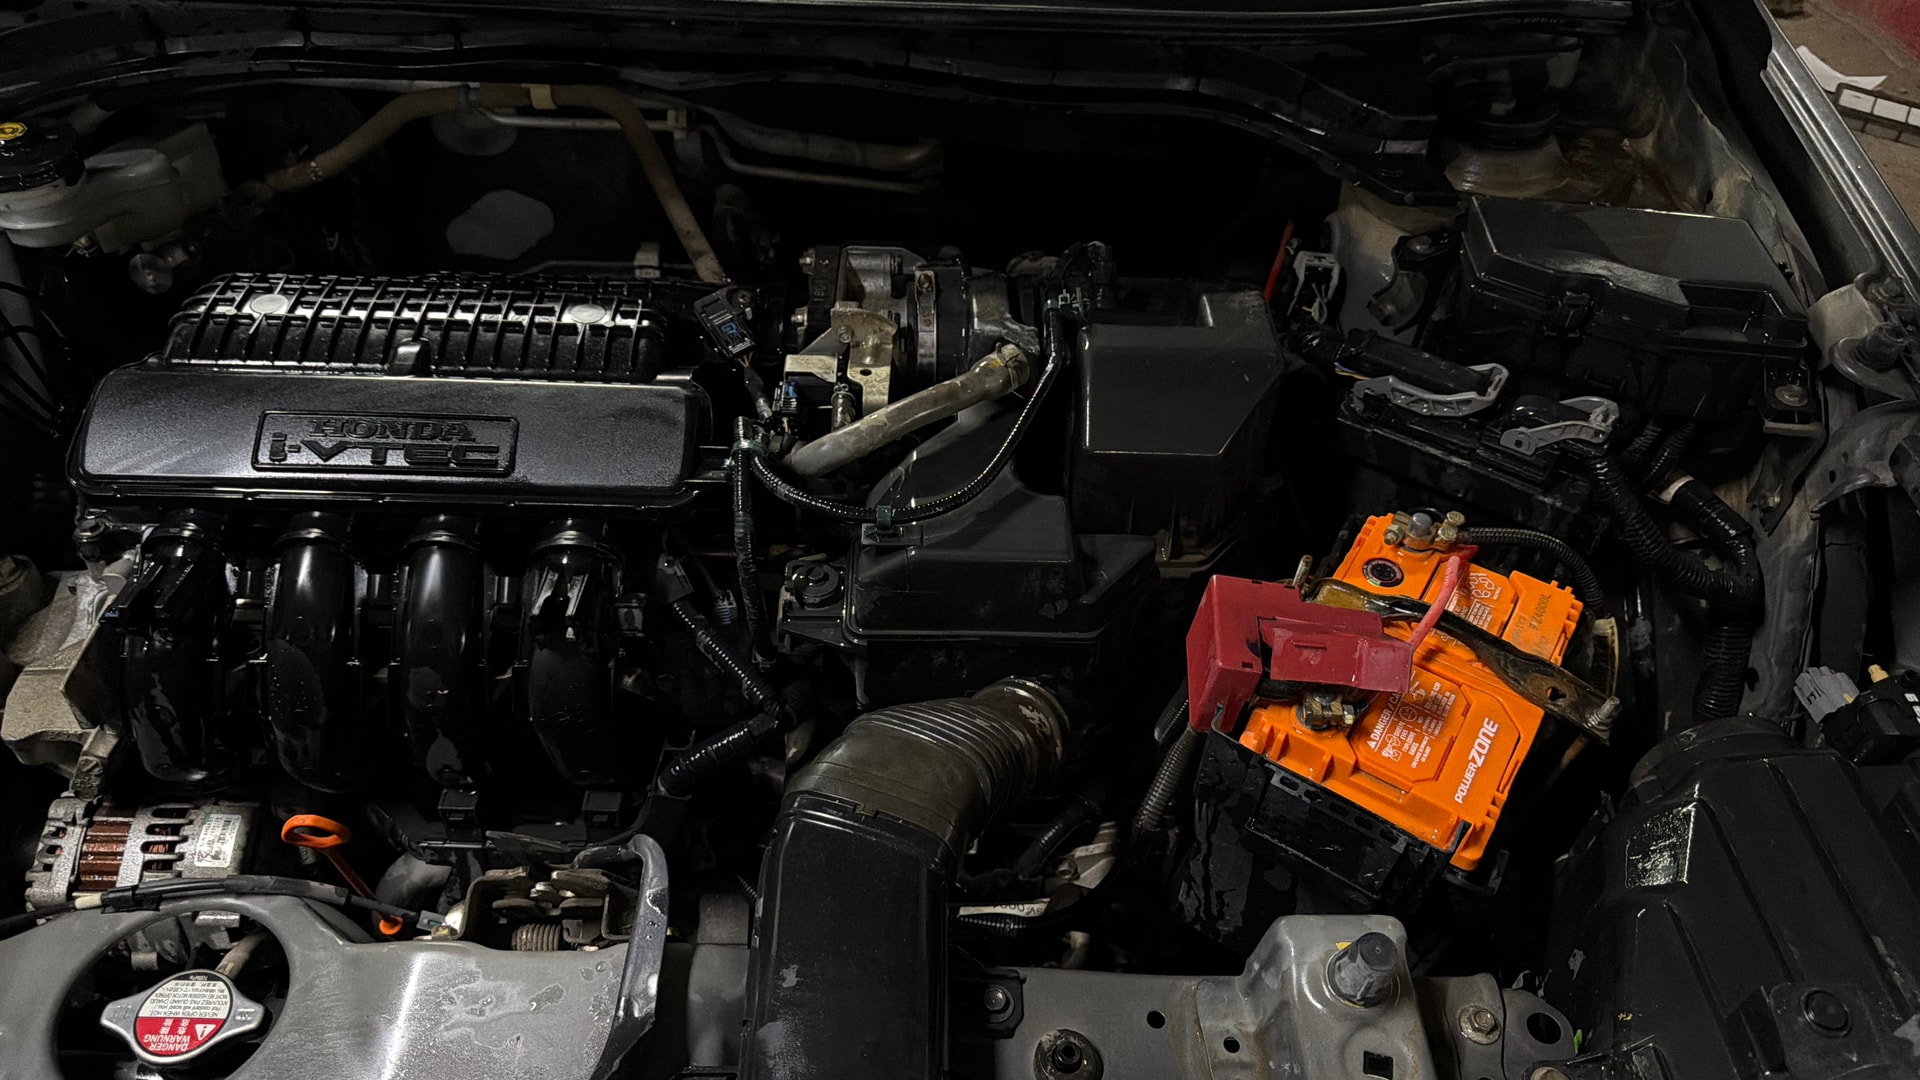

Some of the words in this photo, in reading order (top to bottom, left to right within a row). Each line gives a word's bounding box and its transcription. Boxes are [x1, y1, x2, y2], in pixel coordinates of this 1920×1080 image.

[311, 418, 476, 441] HONDA
[269, 432, 499, 466] i-VTEC
[1370, 708, 1392, 740] DANGER
[143, 1034, 190, 1042] WARNUNG
[149, 1042, 188, 1051] DANGER
